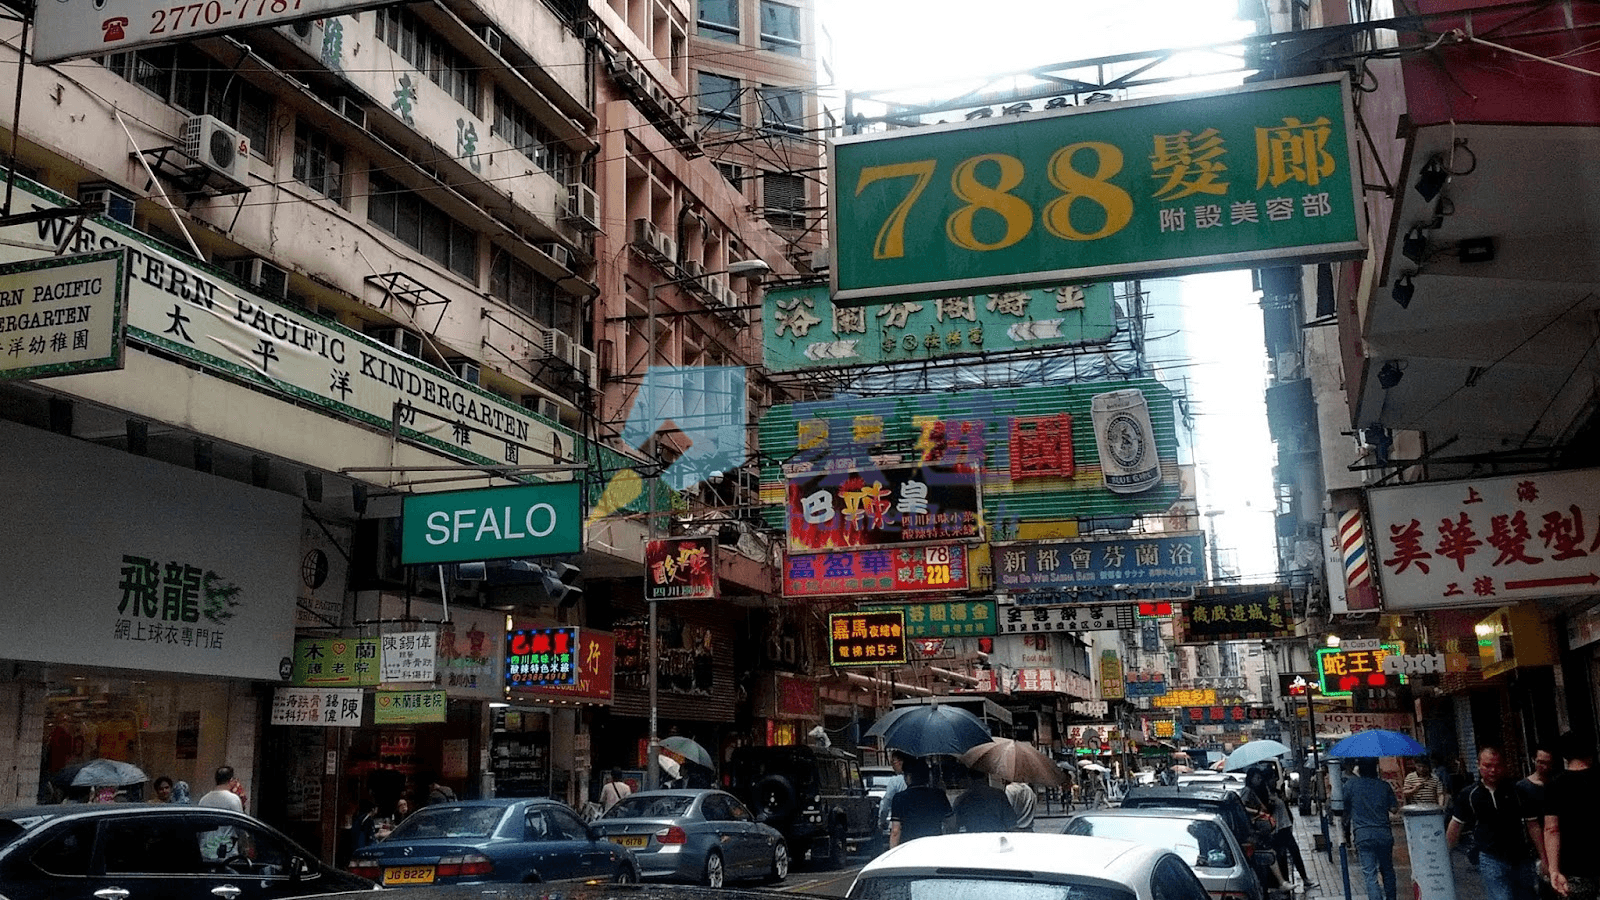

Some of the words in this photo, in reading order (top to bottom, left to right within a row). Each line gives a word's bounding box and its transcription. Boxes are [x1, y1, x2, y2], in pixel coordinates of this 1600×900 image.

[1159, 192, 1332, 233] 附設美容部
[32, 278, 102, 303] PACIFIC
[0, 329, 89, 359] 洋幼稚園
[234, 295, 345, 363] PACIFIC
[360, 351, 529, 442] KINDERGARTEN
[1463, 480, 1540, 504] 上海
[425, 502, 557, 545] SFALO
[927, 547, 948, 562] 78
[1384, 504, 1600, 575] 美華髮型
[1003, 543, 1194, 573] 新都會芬蘭浴
[117, 554, 202, 623] 飛龍
[927, 564, 950, 585] 228
[1443, 575, 1496, 596] 二樓
[114, 618, 225, 650] 網上球衣專門店
[1324, 714, 1372, 723] HOTEL
[387, 870, 401, 880] JG
[403, 869, 432, 880] 8227
